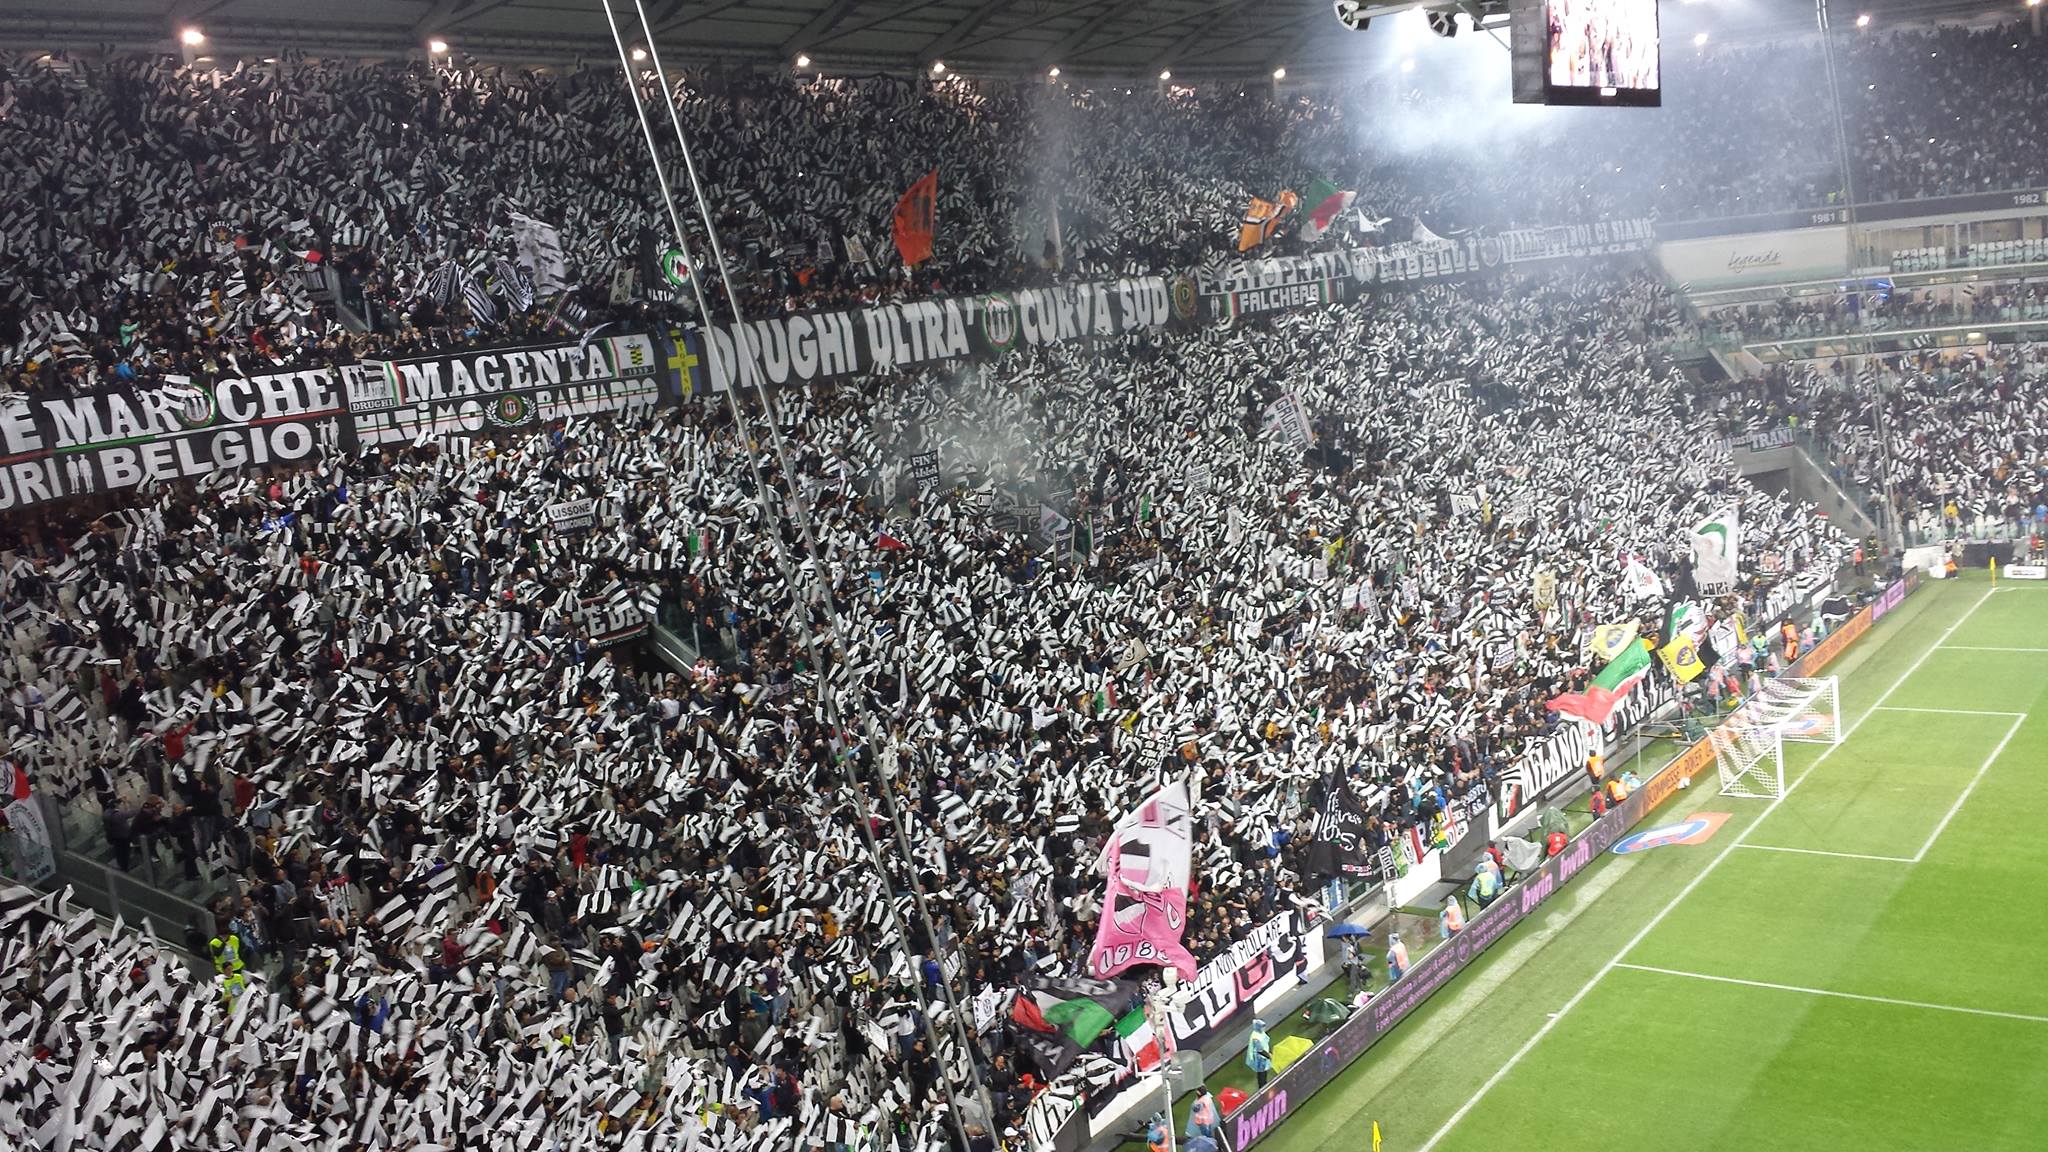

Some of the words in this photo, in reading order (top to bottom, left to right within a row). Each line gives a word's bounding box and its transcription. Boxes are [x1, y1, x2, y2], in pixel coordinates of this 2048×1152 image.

[699, 312, 858, 394] DRUGHI
[1018, 282, 1115, 345] CURVA
[1120, 275, 1170, 326] SUD
[397, 344, 613, 403] MAGENTA
[351, 398, 394, 413] DRUGHI
[98, 421, 313, 490] BELGIO
[552, 503, 591, 518] LISSONE
[1521, 872, 1553, 913] bwin
[1236, 1089, 1288, 1152] bwin
